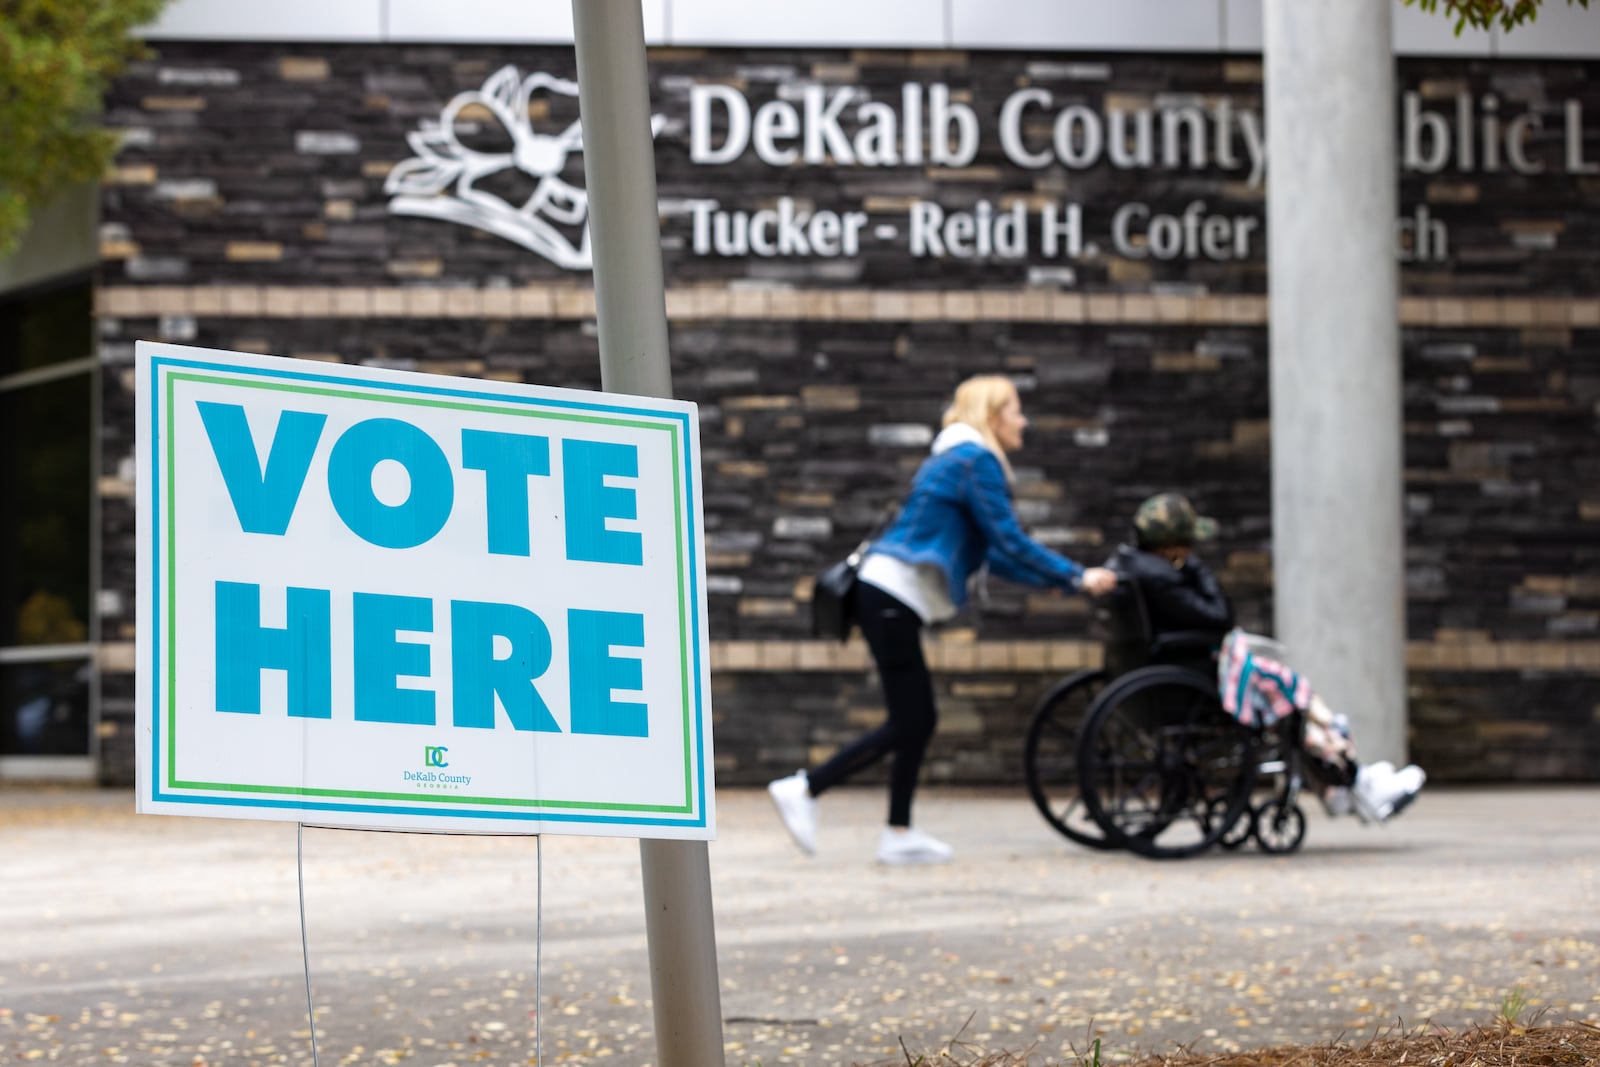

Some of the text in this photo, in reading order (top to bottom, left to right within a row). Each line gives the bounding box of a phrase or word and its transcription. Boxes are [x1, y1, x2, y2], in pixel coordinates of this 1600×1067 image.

[689, 84, 981, 167] DeKalb
[1403, 90, 1545, 174] blic
[690, 197, 868, 257] Tucker
[909, 201, 1026, 257] Reid
[1041, 204, 1099, 257] H.
[1113, 203, 1258, 260] Cofer
[196, 401, 644, 566] VOTE
[214, 580, 649, 738] HERE
[403, 770, 472, 786] DeKalb County
